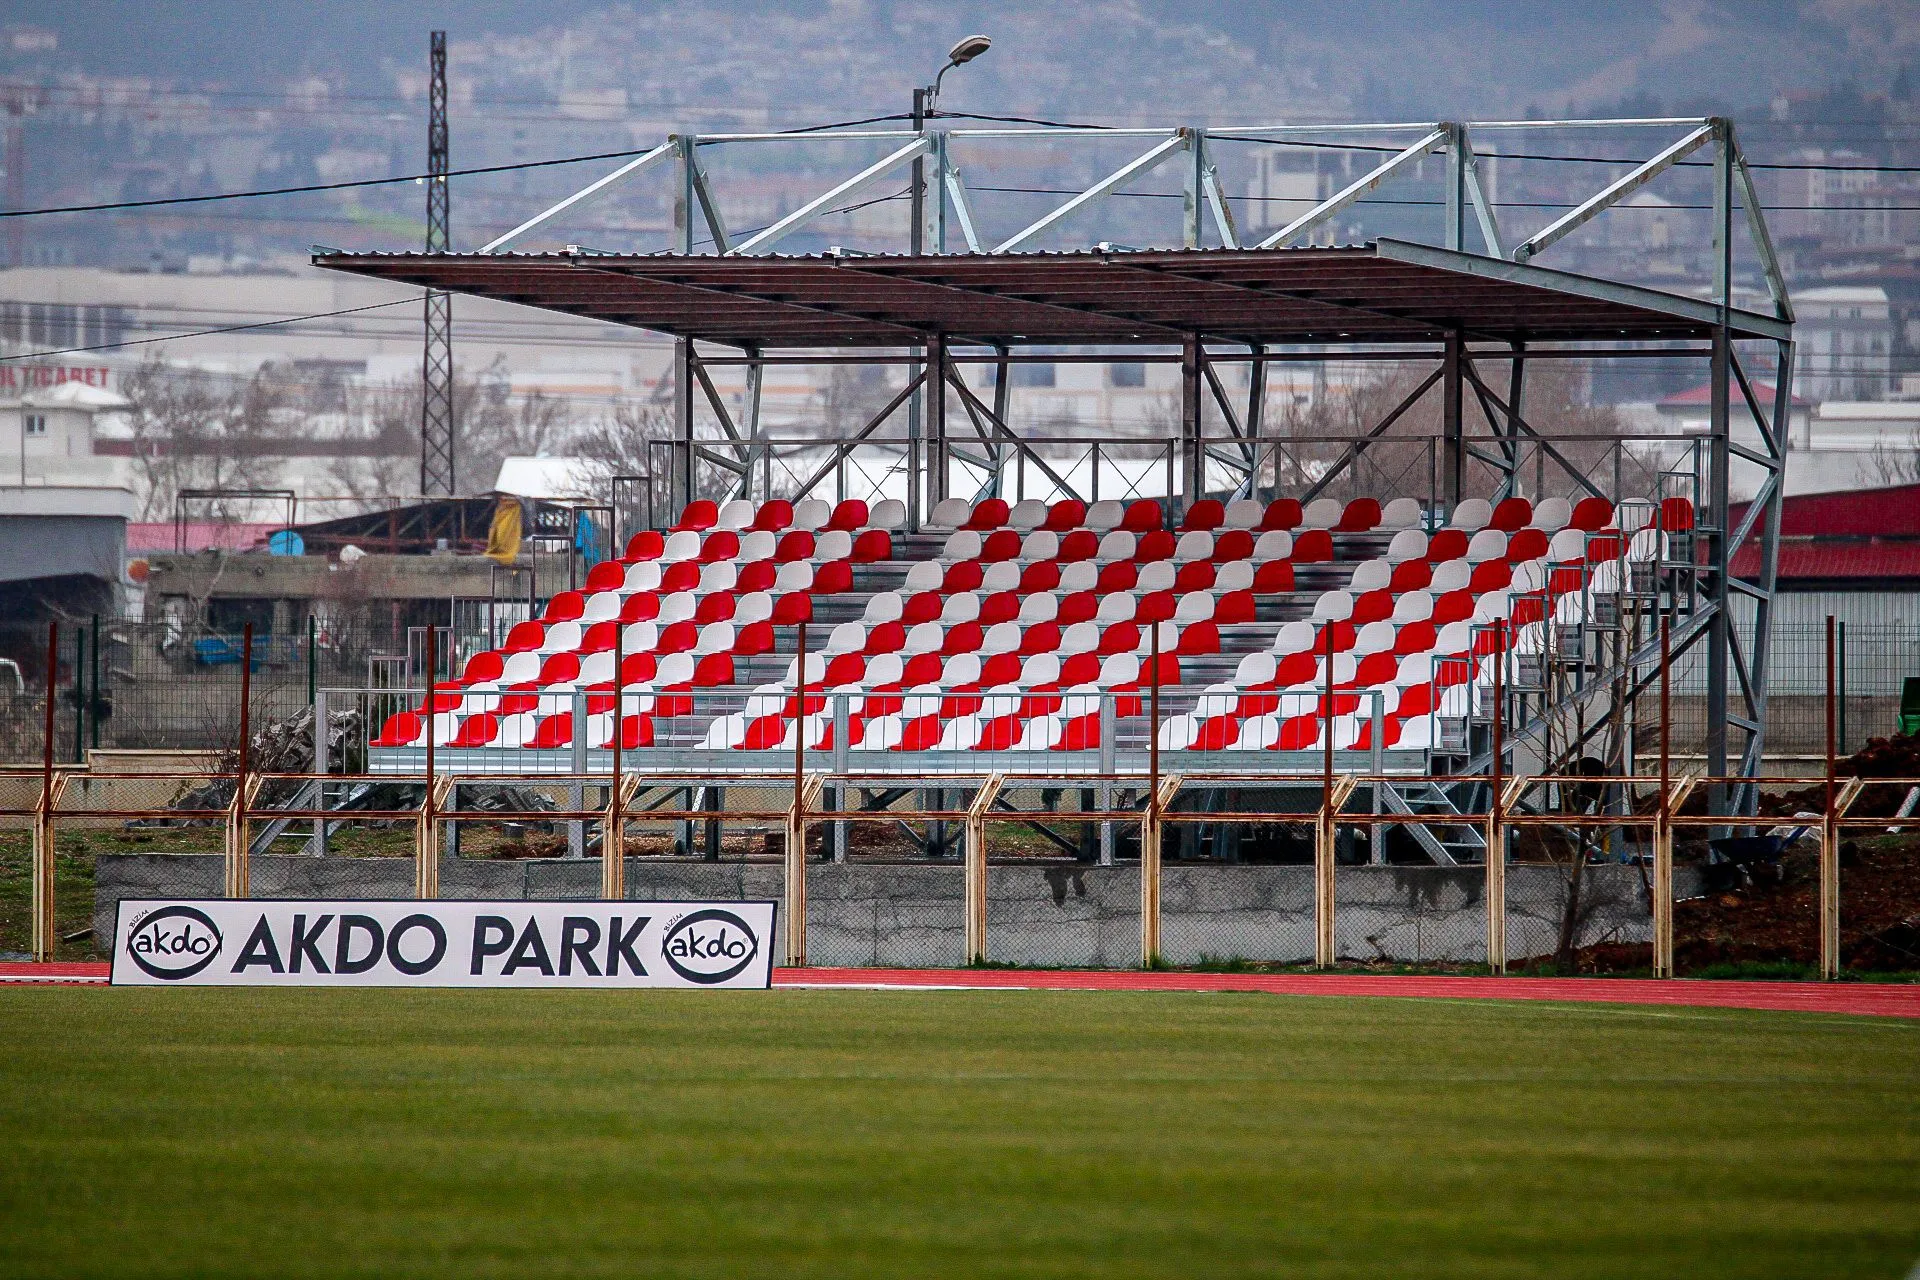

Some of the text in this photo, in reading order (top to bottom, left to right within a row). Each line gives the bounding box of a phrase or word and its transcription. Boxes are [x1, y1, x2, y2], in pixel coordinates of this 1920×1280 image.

[135, 922, 211, 956] akdo
[230, 912, 652, 977] AKDO PARK
[670, 926, 746, 959] akdo
